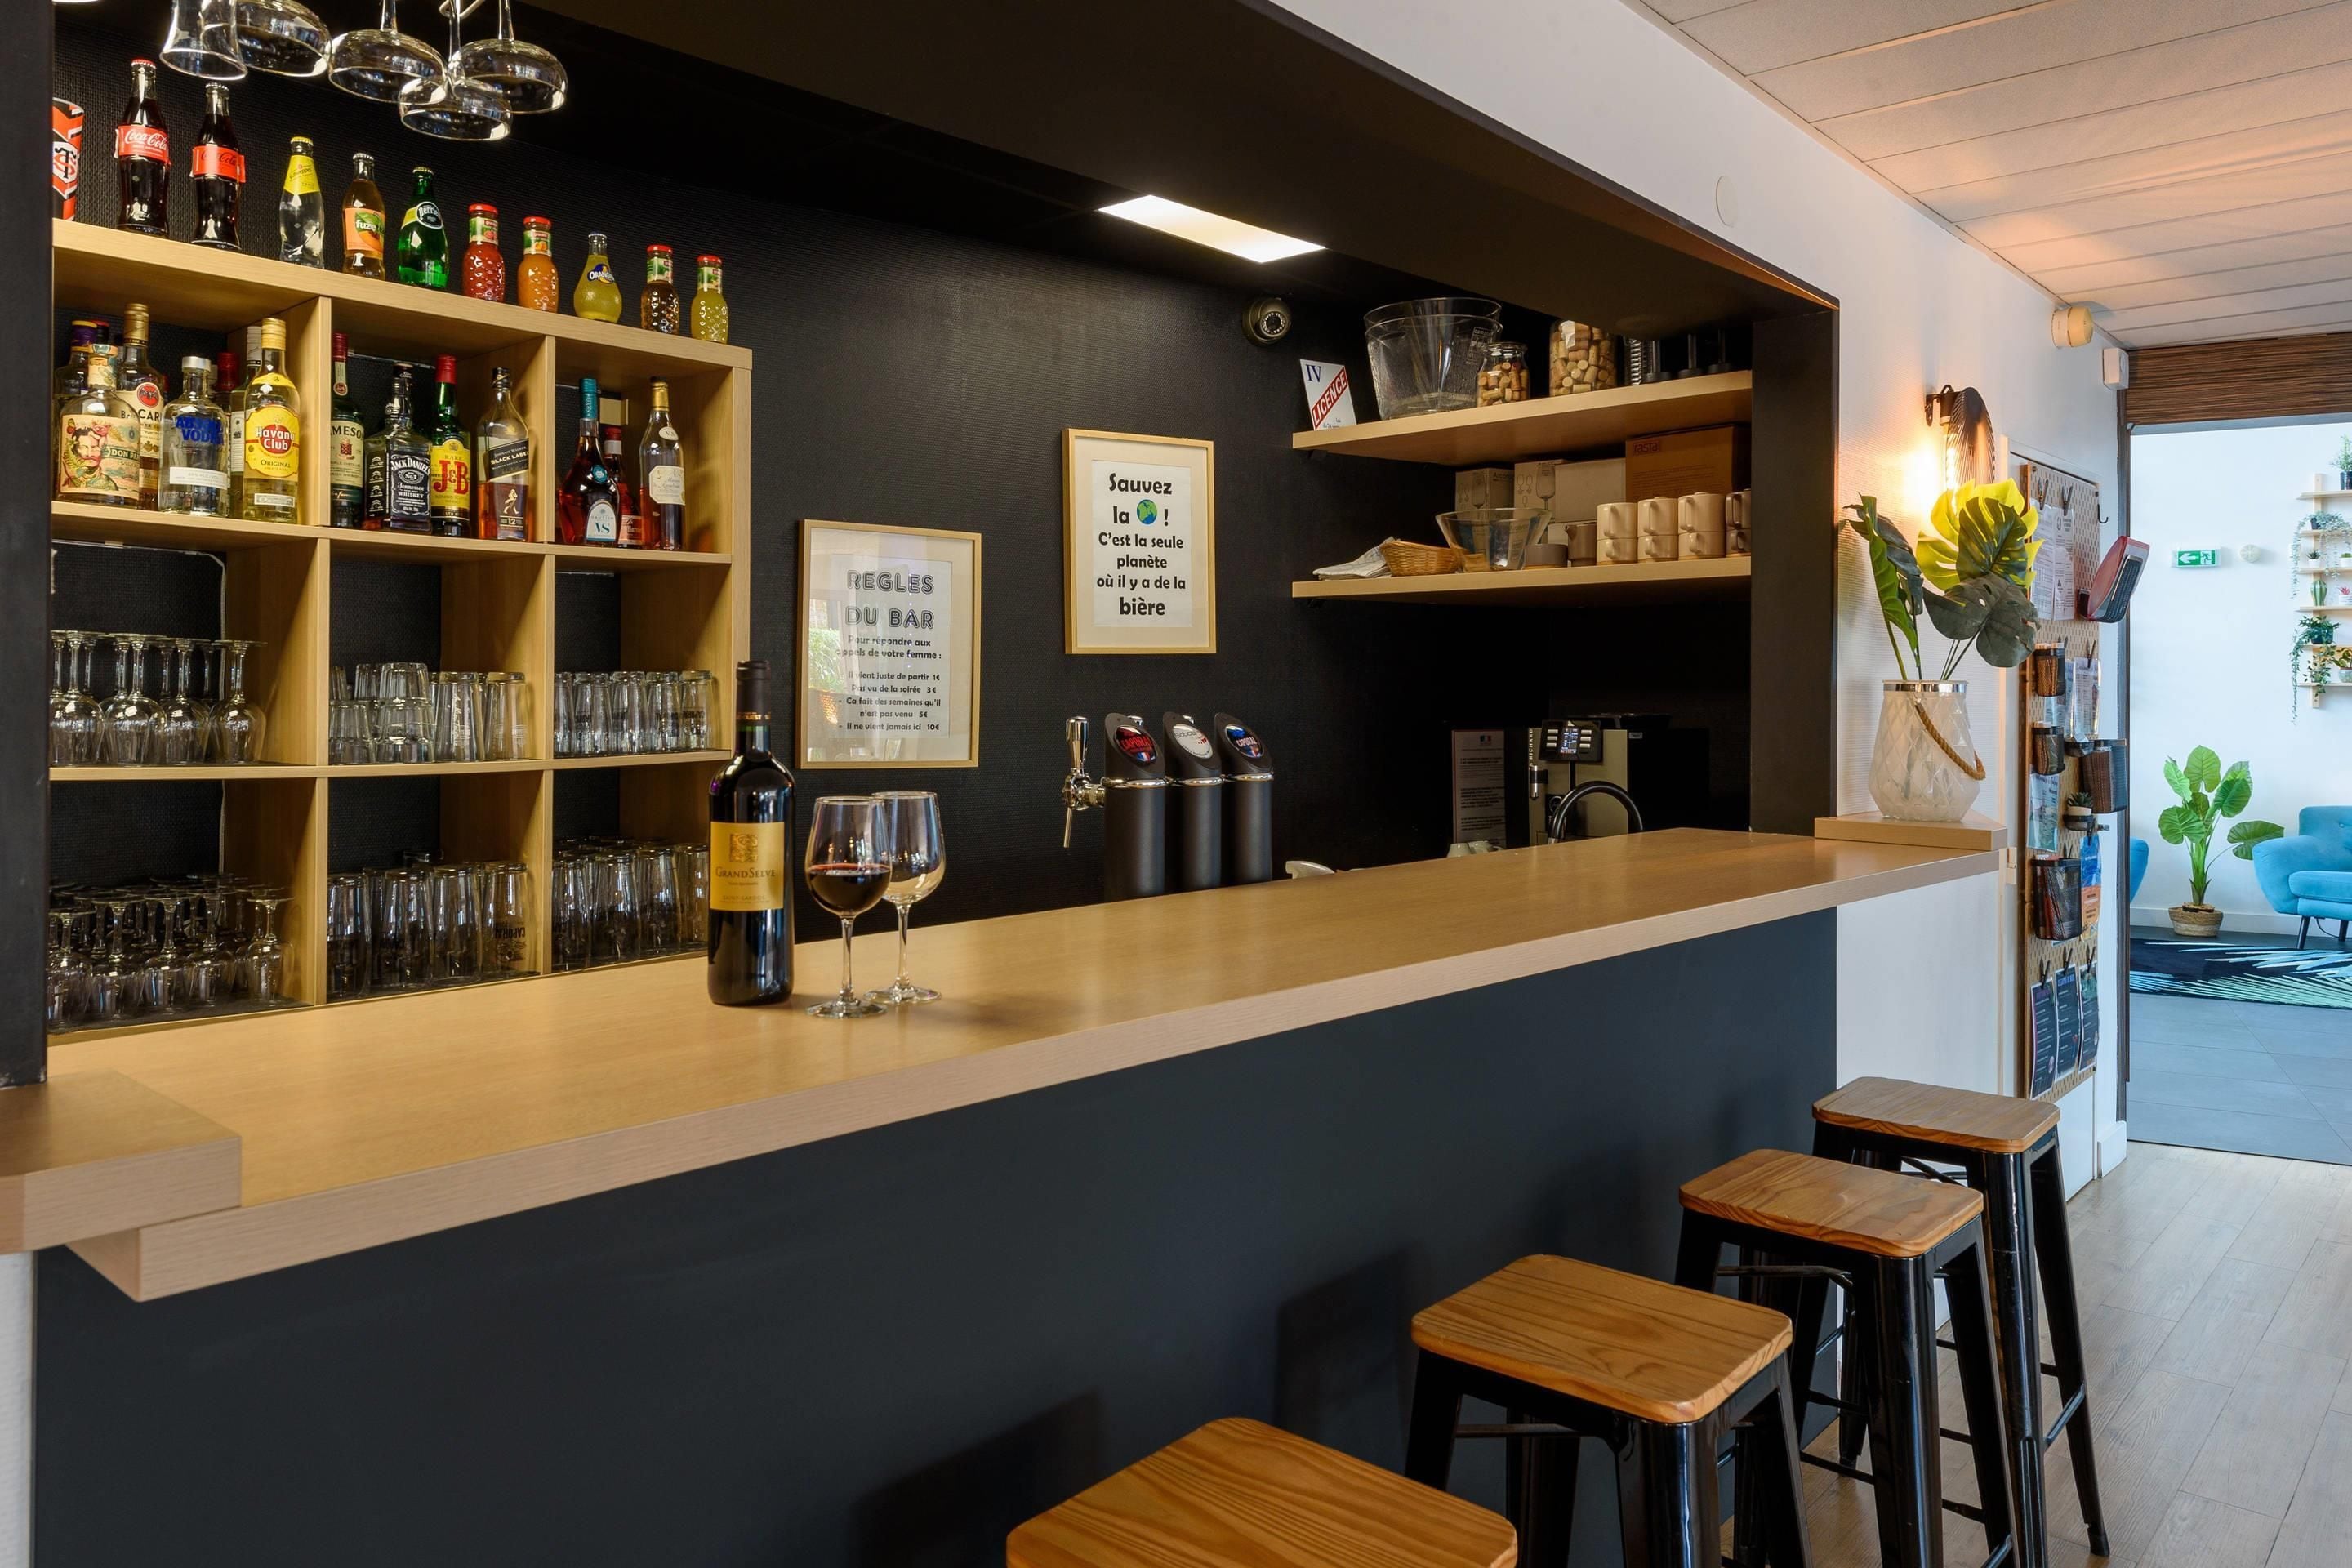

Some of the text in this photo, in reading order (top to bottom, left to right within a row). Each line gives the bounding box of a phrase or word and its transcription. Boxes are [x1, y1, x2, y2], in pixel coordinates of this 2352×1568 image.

[355, 220, 376, 232] fuze
[1306, 364, 1321, 383] IV
[1312, 370, 1347, 425] LICENCE
[256, 425, 295, 441] Havana
[263, 437, 289, 451] Club
[111, 448, 129, 457] DON
[260, 459, 291, 469] ORIGINAL
[390, 459, 407, 472] JACK
[490, 456, 510, 466] BLACK
[1109, 473, 1172, 495] Sauvez
[1113, 506, 1169, 527] la !
[595, 522, 610, 534] VS
[1098, 532, 1183, 549] C'est la seule
[1116, 554, 1167, 570] planète
[847, 570, 934, 595] REGLES
[1097, 573, 1186, 591] où il y a de la
[1119, 596, 1165, 616] bière
[845, 606, 934, 629] DU BAR
[848, 635, 931, 647] Pour répondre aux
[868, 648, 880, 657] de
[882, 649, 905, 658] votre
[906, 649, 937, 659] femme
[876, 672, 895, 680] juste
[897, 672, 906, 680] de
[907, 673, 929, 681] partir
[880, 684, 889, 693] de
[900, 685, 921, 693] soirée
[858, 697, 873, 705] fait
[875, 697, 887, 706] des
[889, 698, 923, 706] semaines
[865, 722, 884, 730] vient
[886, 723, 911, 731] jamais
[913, 723, 921, 731] ici
